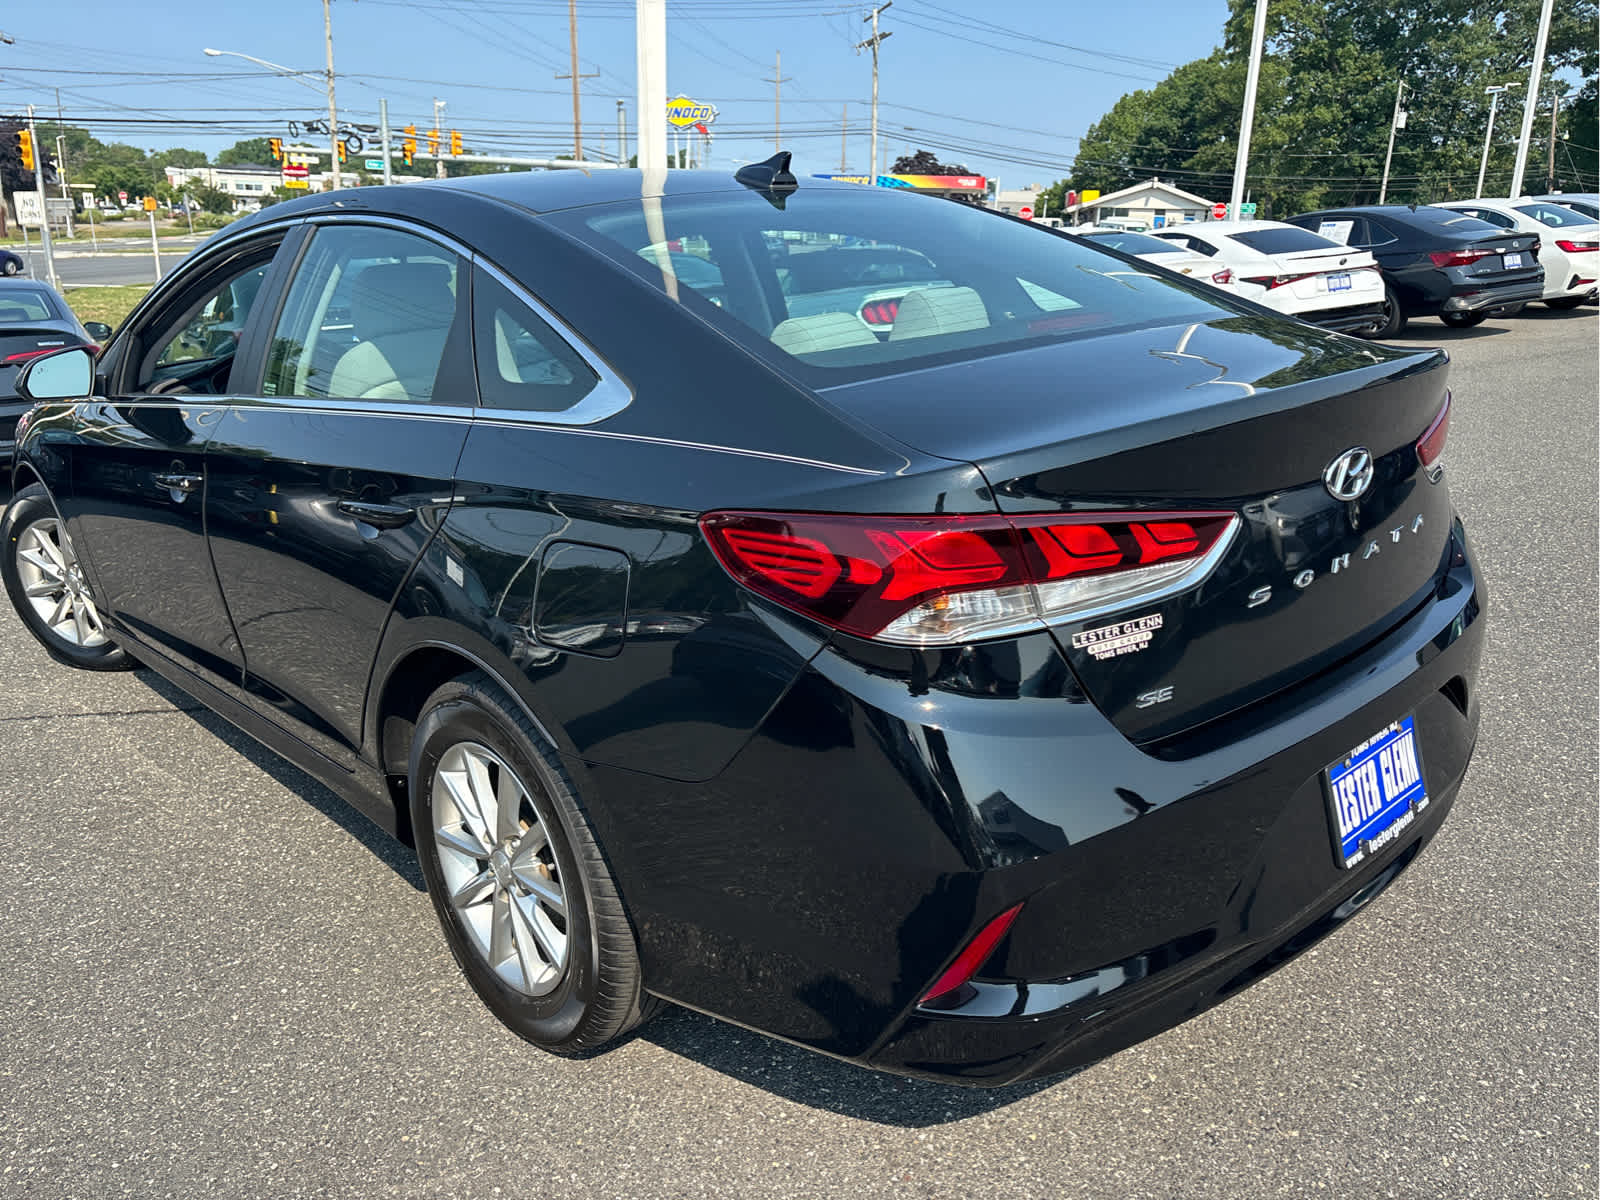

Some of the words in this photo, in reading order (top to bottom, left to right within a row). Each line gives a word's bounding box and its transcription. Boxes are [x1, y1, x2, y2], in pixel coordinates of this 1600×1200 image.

[666, 107, 709, 118] UNOCO
[1212, 207, 1226, 215] STOP
[1248, 513, 1424, 608] SONATA
[1072, 626, 1120, 647] LESTER
[1123, 615, 1163, 633] GLENN
[1091, 642, 1115, 652] AUTO
[1120, 633, 1150, 645] GROUP
[1095, 650, 1115, 660] TOMS
[1139, 641, 1149, 649] NJ
[1135, 685, 1174, 708] SE
[1351, 740, 1369, 759] TOMS
[1332, 759, 1382, 838] LESTER
[1379, 732, 1420, 802] GLENN
